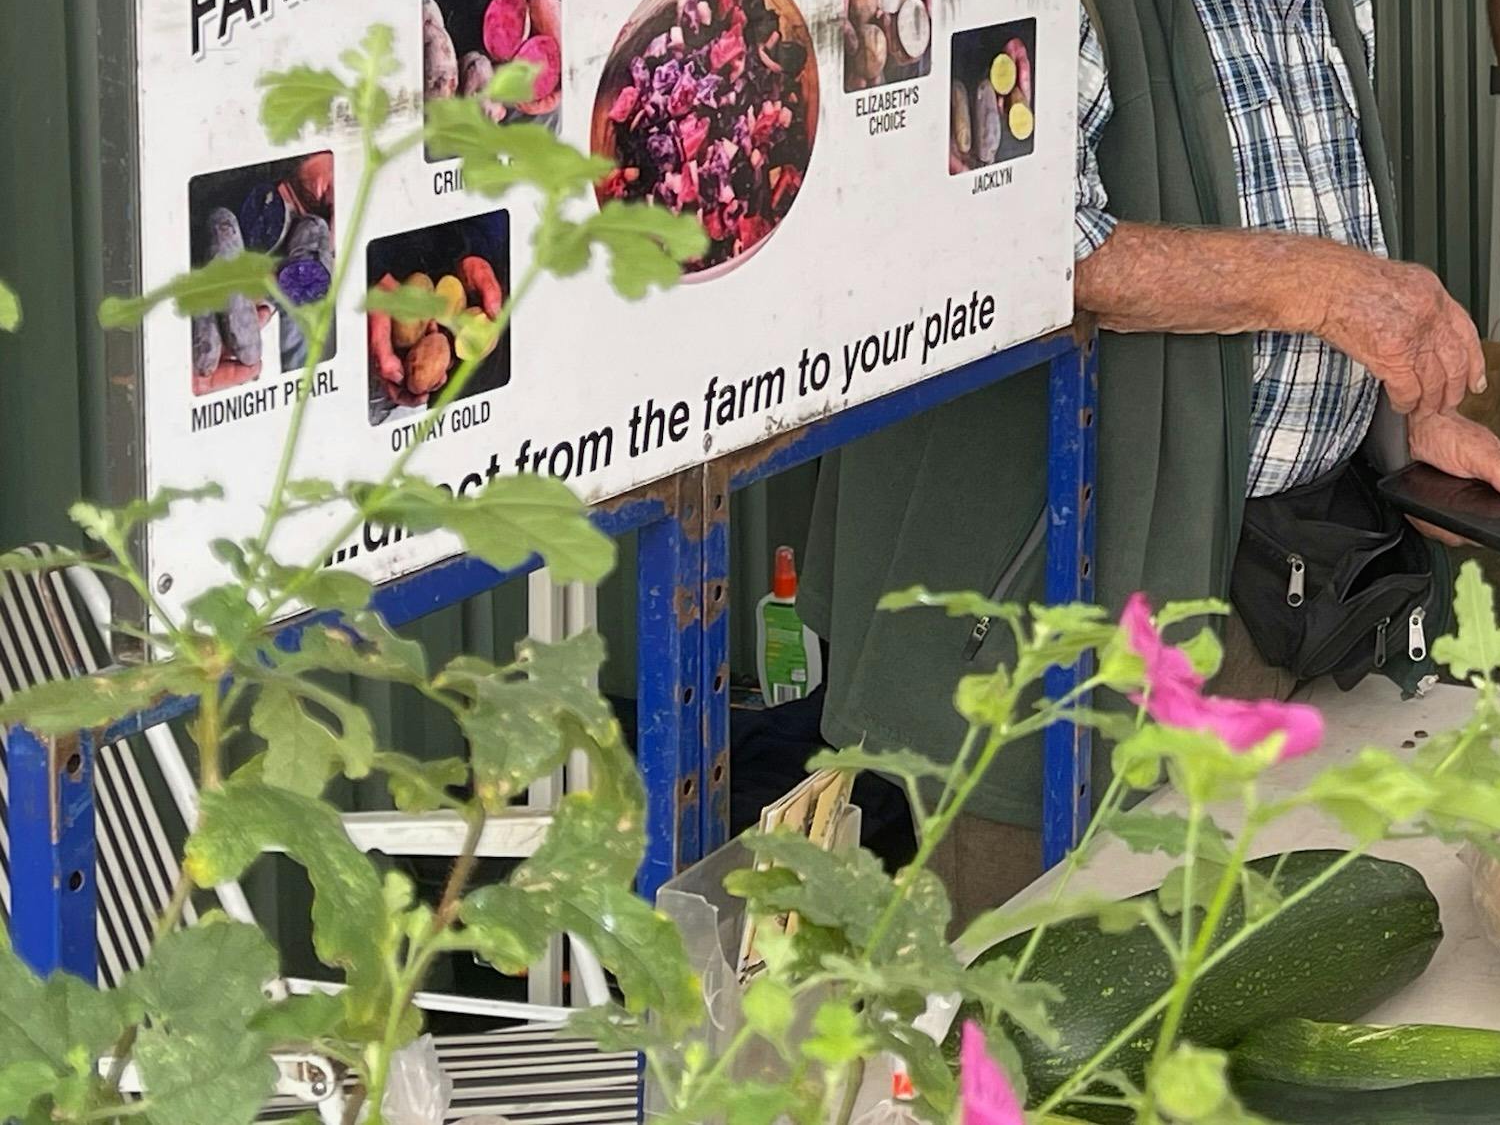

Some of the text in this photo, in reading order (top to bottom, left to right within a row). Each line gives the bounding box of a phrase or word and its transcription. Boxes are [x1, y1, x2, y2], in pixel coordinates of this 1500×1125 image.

[855, 85, 919, 117] ELIZABETH'S
[869, 110, 906, 136] CHOICE
[972, 166, 1012, 194] JACKLYN
[629, 399, 689, 458] the
[704, 367, 785, 431] farm
[799, 349, 831, 396] to
[842, 320, 914, 394] your
[920, 291, 995, 364] plate
[191, 385, 278, 432] MIDNIGHT
[452, 401, 490, 433] GOLD
